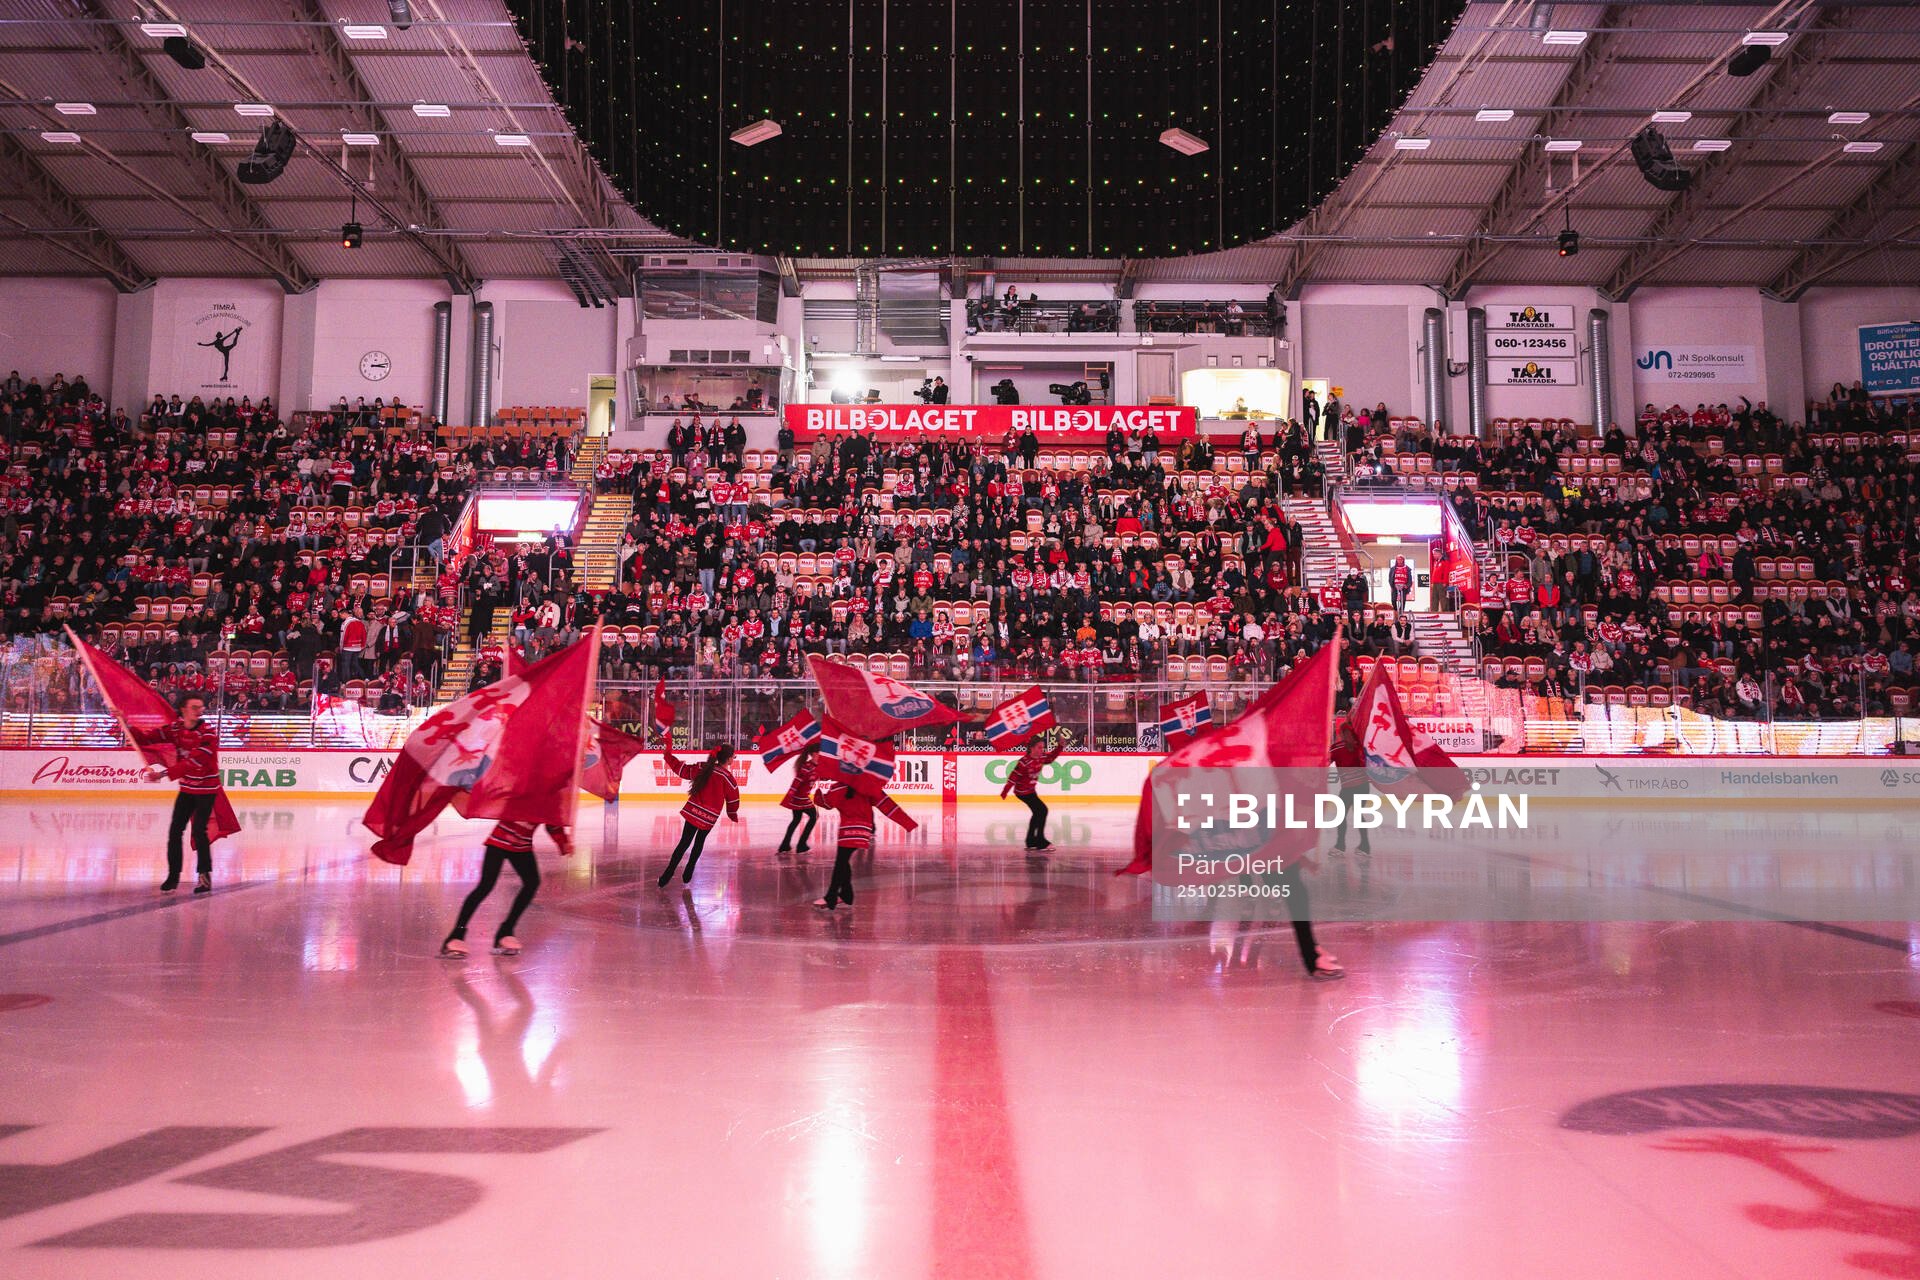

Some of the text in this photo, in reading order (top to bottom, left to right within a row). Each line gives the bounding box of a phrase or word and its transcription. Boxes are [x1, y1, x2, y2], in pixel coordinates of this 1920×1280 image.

[1510, 312, 1550, 322] TAXI
[1495, 339, 1566, 348] 060-123456
[1691, 354, 1744, 363] Spolkonsult
[1512, 368, 1551, 378] TAXI
[807, 409, 1182, 432] BILBOLAGET BILBOLAGET
[1417, 722, 1475, 733] BUCHER
[1453, 737, 1475, 747] glass
[222, 756, 287, 764] RENHÅLLNINGS
[348, 757, 394, 783] CA
[984, 760, 1092, 791] cop
[1464, 769, 1560, 785] BOLAGET
[1627, 776, 1689, 789] TIMRÅBO
[1720, 772, 1838, 784] Handelsbanken
